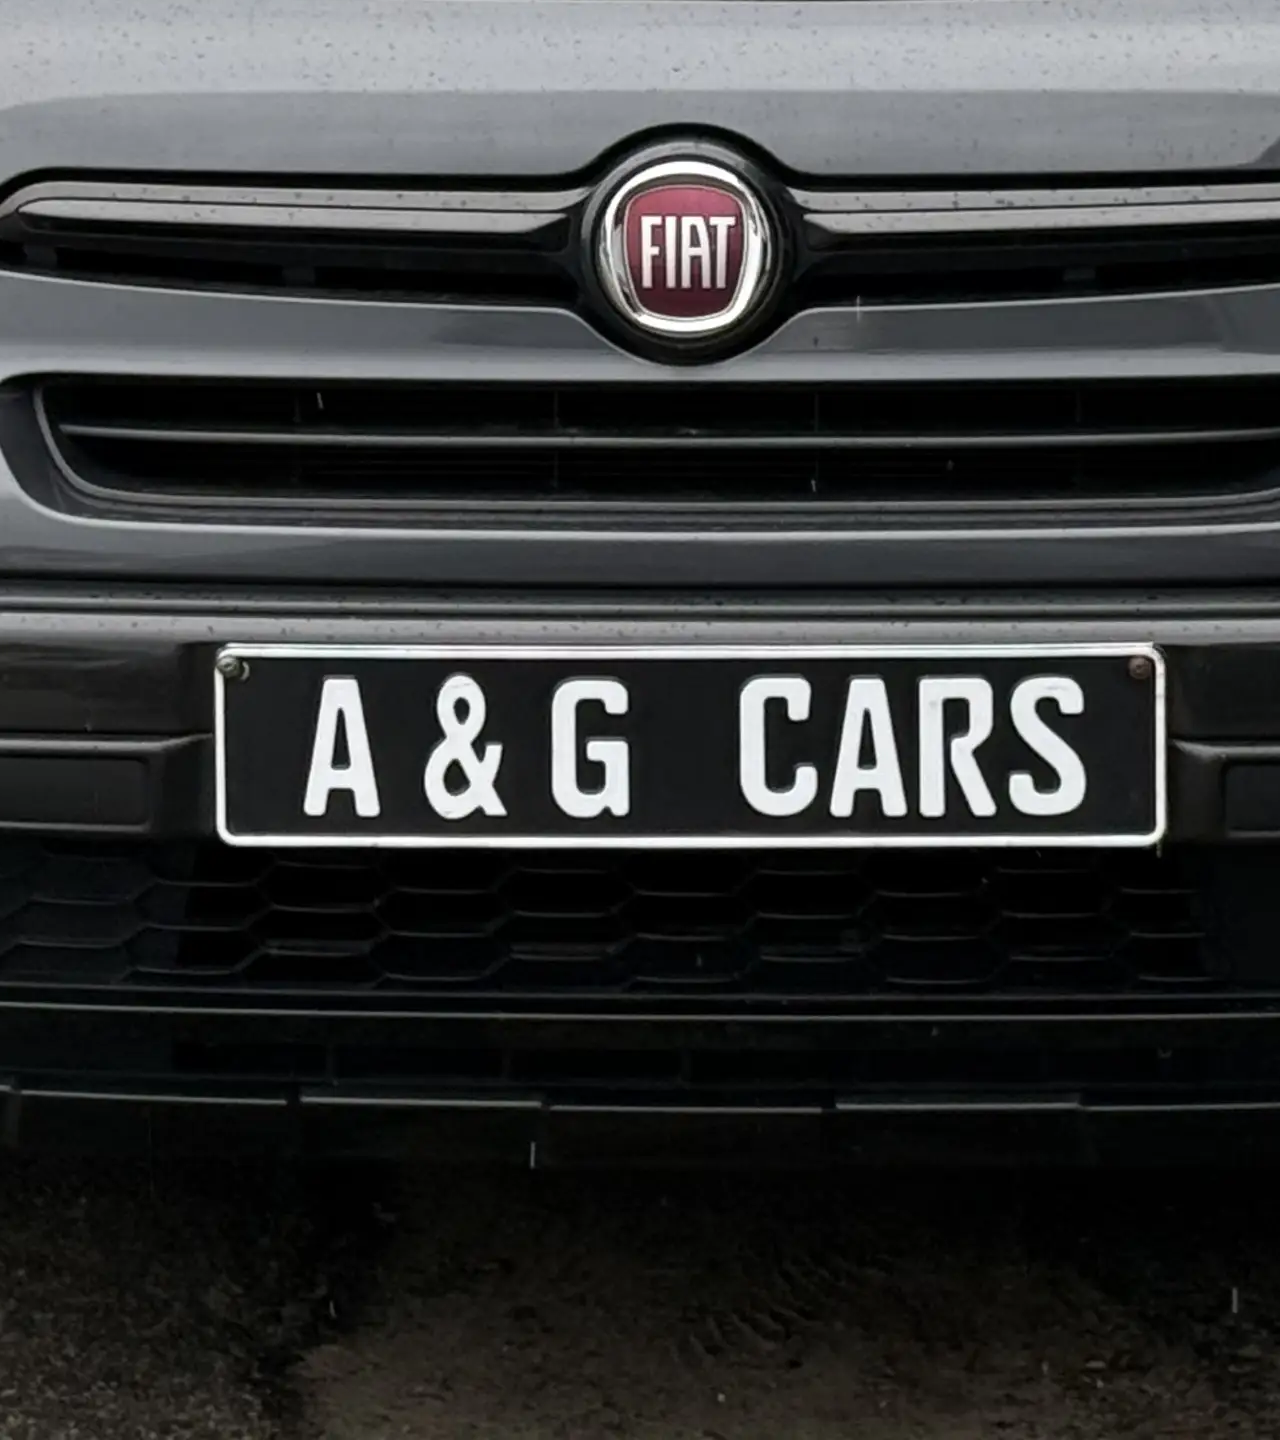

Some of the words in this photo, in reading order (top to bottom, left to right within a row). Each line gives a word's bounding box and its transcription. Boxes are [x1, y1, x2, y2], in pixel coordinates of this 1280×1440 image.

[640, 215, 736, 290] FIAT
[302, 677, 382, 818] A
[423, 673, 508, 820] &
[550, 678, 631, 819] G
[738, 675, 1087, 818] CARS
